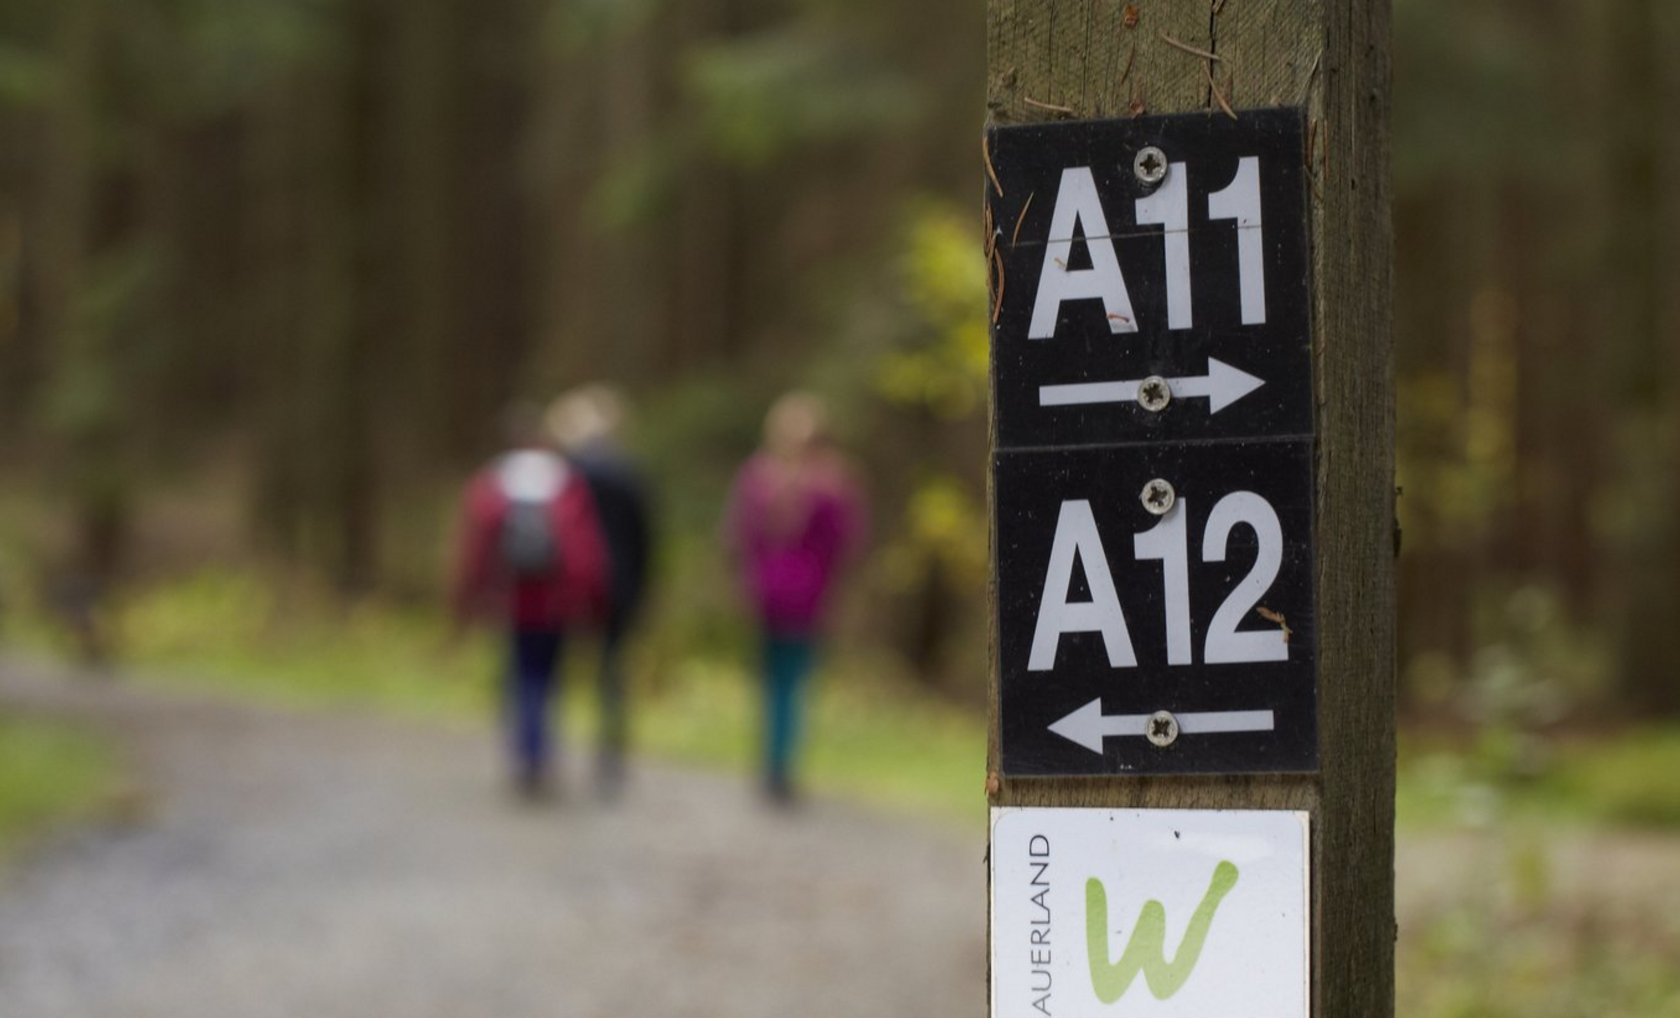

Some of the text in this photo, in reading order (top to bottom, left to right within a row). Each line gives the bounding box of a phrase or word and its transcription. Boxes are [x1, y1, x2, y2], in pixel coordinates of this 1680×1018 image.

[1028, 156, 1266, 340] A11
[1027, 490, 1289, 671] A12
[1029, 834, 1052, 1017] AUERLAND
